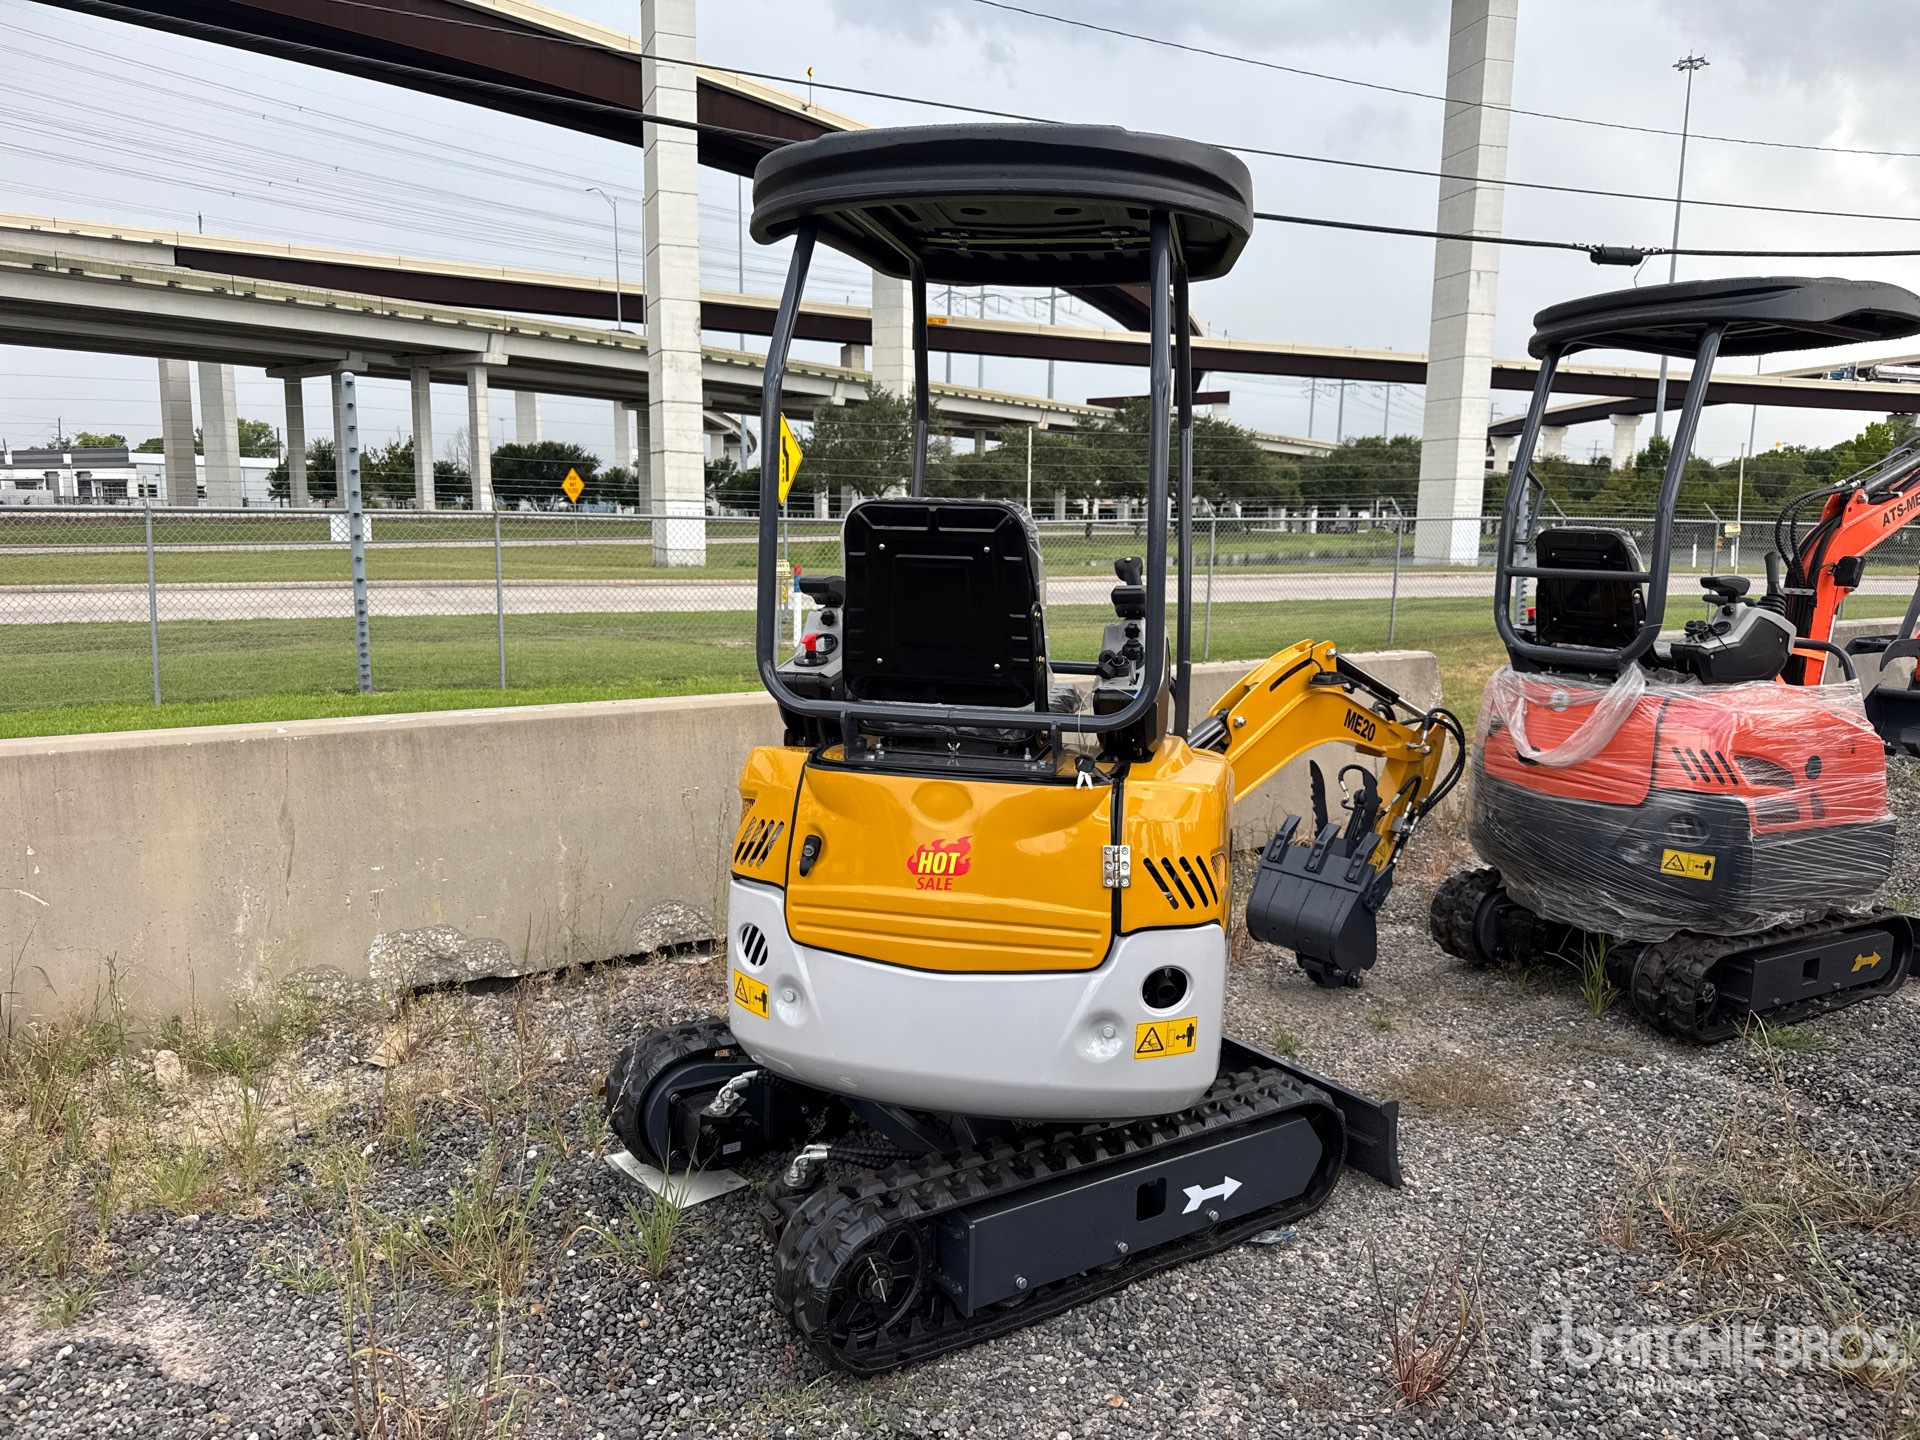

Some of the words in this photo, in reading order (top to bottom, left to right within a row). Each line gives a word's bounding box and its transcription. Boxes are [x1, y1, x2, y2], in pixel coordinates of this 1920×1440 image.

[1343, 708, 1376, 742] ME20
[917, 851, 961, 874] HOT
[915, 876, 953, 891] SALE
